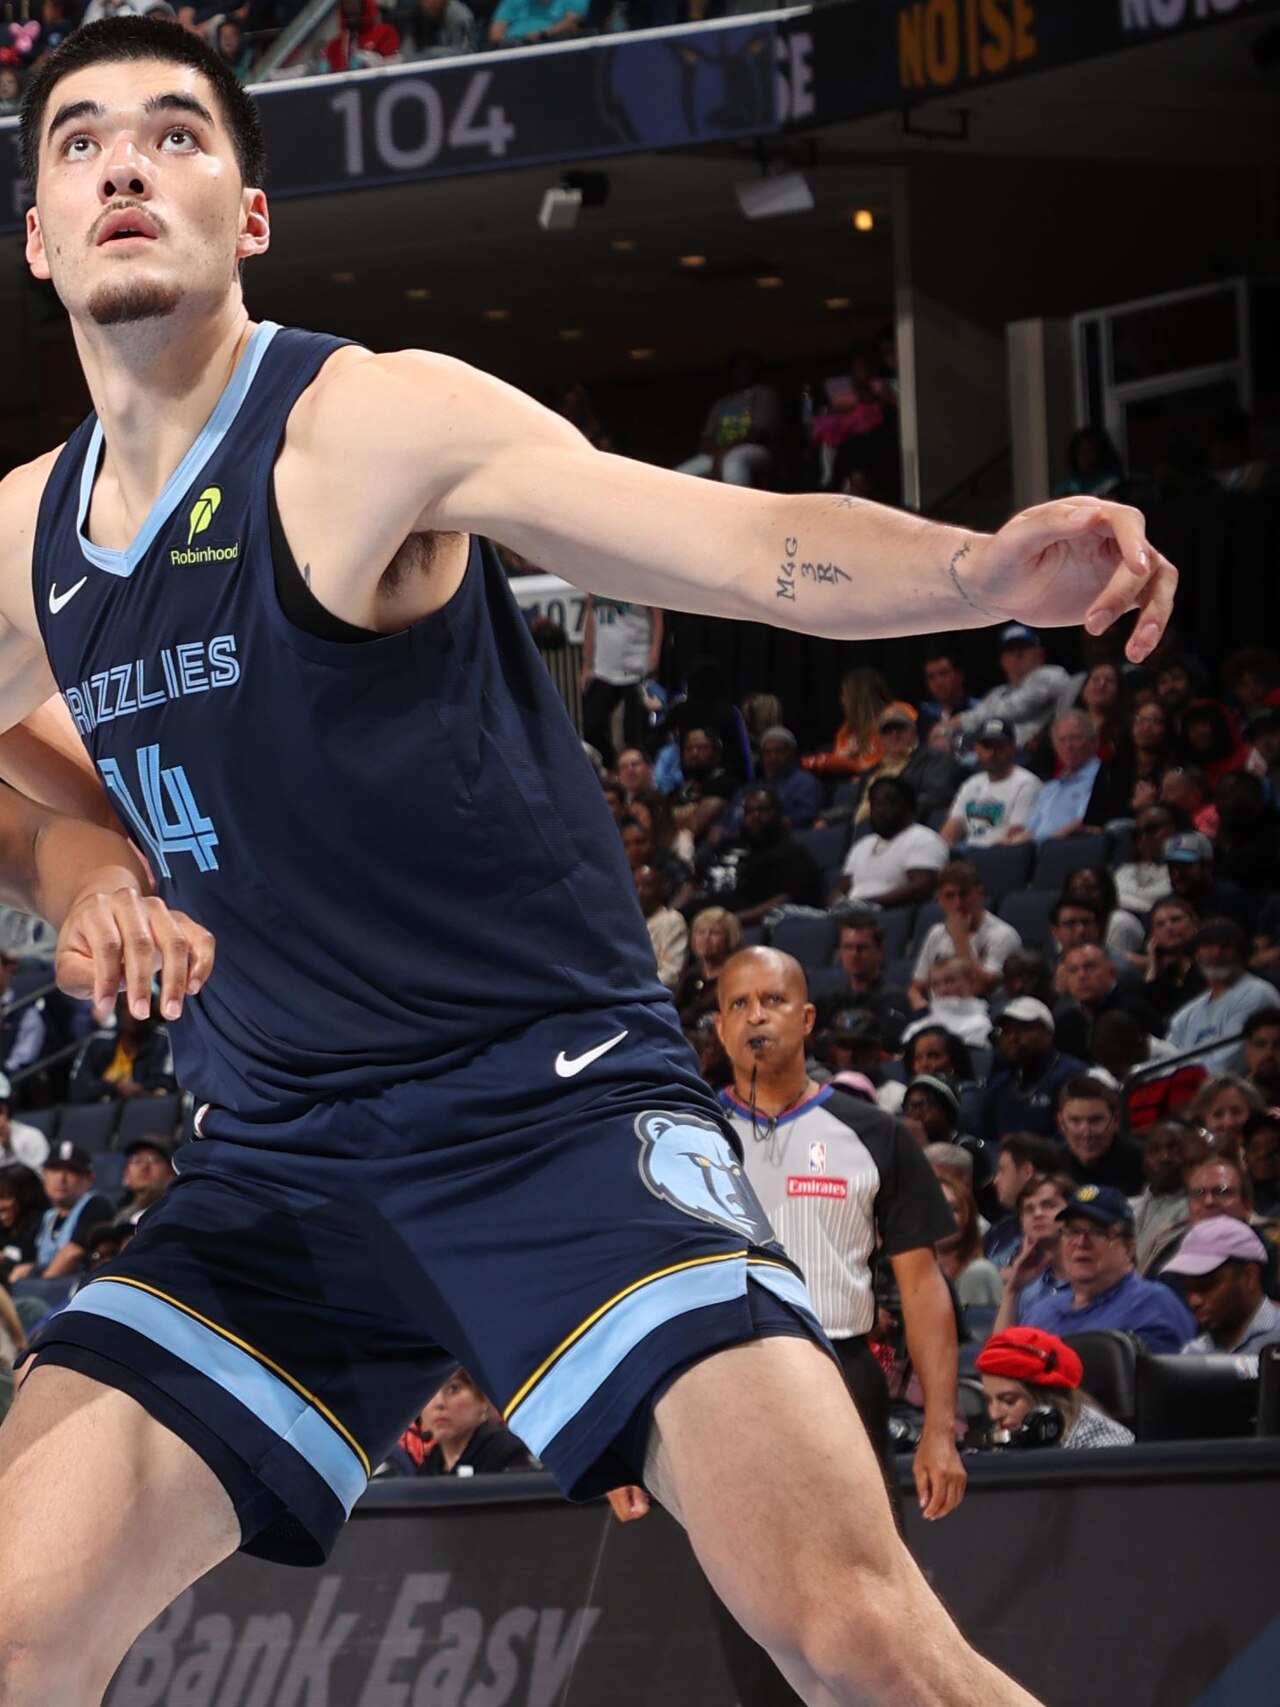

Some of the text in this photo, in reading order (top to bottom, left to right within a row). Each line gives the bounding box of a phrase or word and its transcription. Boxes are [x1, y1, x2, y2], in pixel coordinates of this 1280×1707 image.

[332, 72, 514, 175] 104
[170, 544, 238, 566] Robinhood
[63, 634, 241, 736] RIZZLIES
[97, 743, 219, 878] 14
[788, 1178, 846, 1197] Emirates
